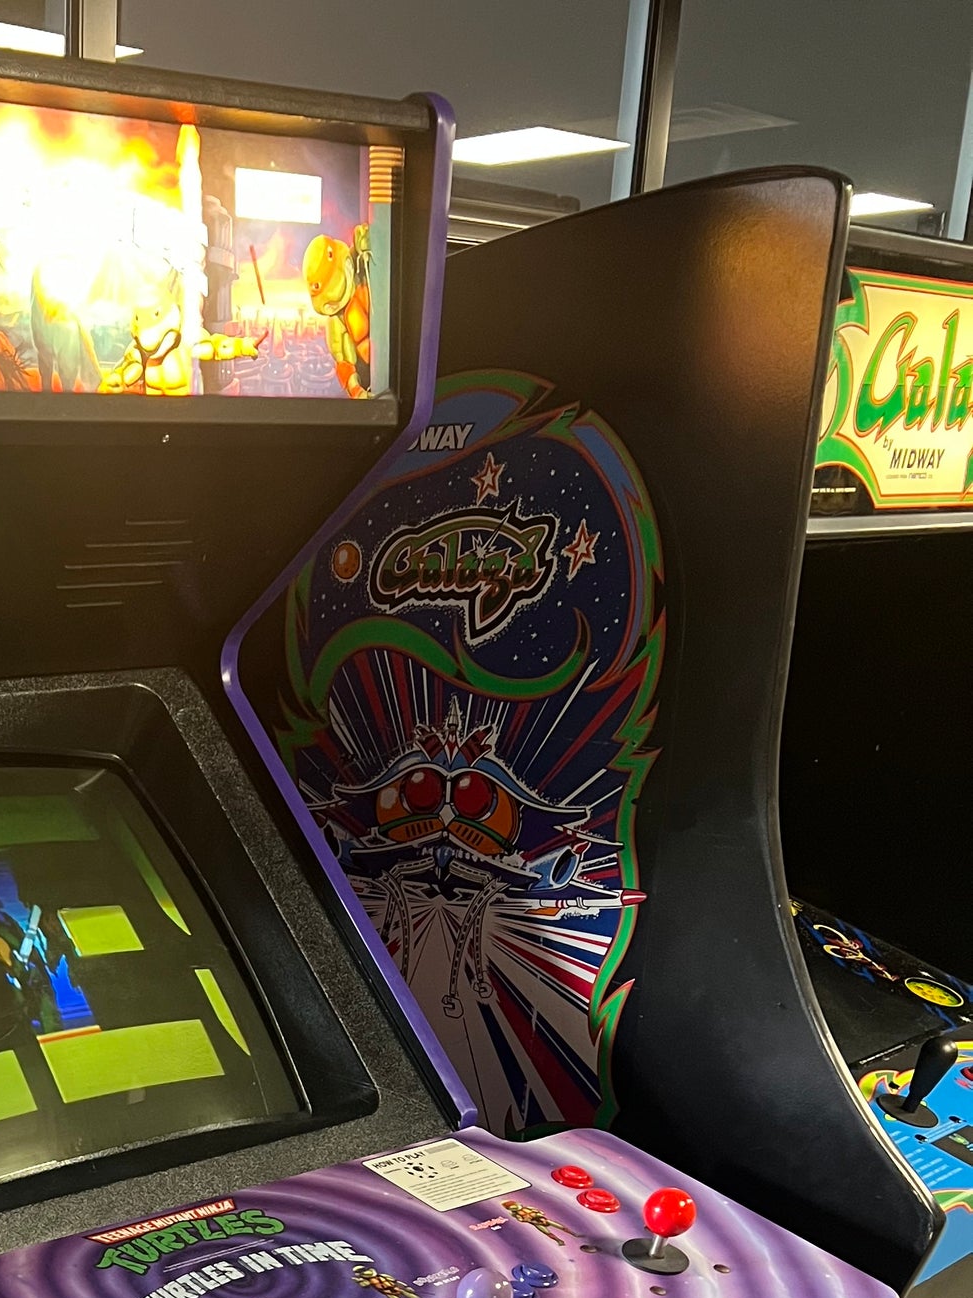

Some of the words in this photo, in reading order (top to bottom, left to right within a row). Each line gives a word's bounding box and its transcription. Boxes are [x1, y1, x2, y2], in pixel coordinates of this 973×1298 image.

[408, 422, 476, 452] WAY
[882, 435, 894, 451] by
[889, 448, 946, 470] MIDWAY
[375, 512, 552, 632] Galaga
[372, 1158, 394, 1170] HOW
[392, 1156, 406, 1165] TO
[404, 1150, 427, 1161] PLAY
[88, 1219, 157, 1243] TEENAGE
[155, 1209, 198, 1231] MUTANT
[196, 1200, 234, 1217] NINJA
[96, 1210, 286, 1275] TURTLES
[239, 1252, 284, 1274] IN
[273, 1240, 375, 1266] TIME
